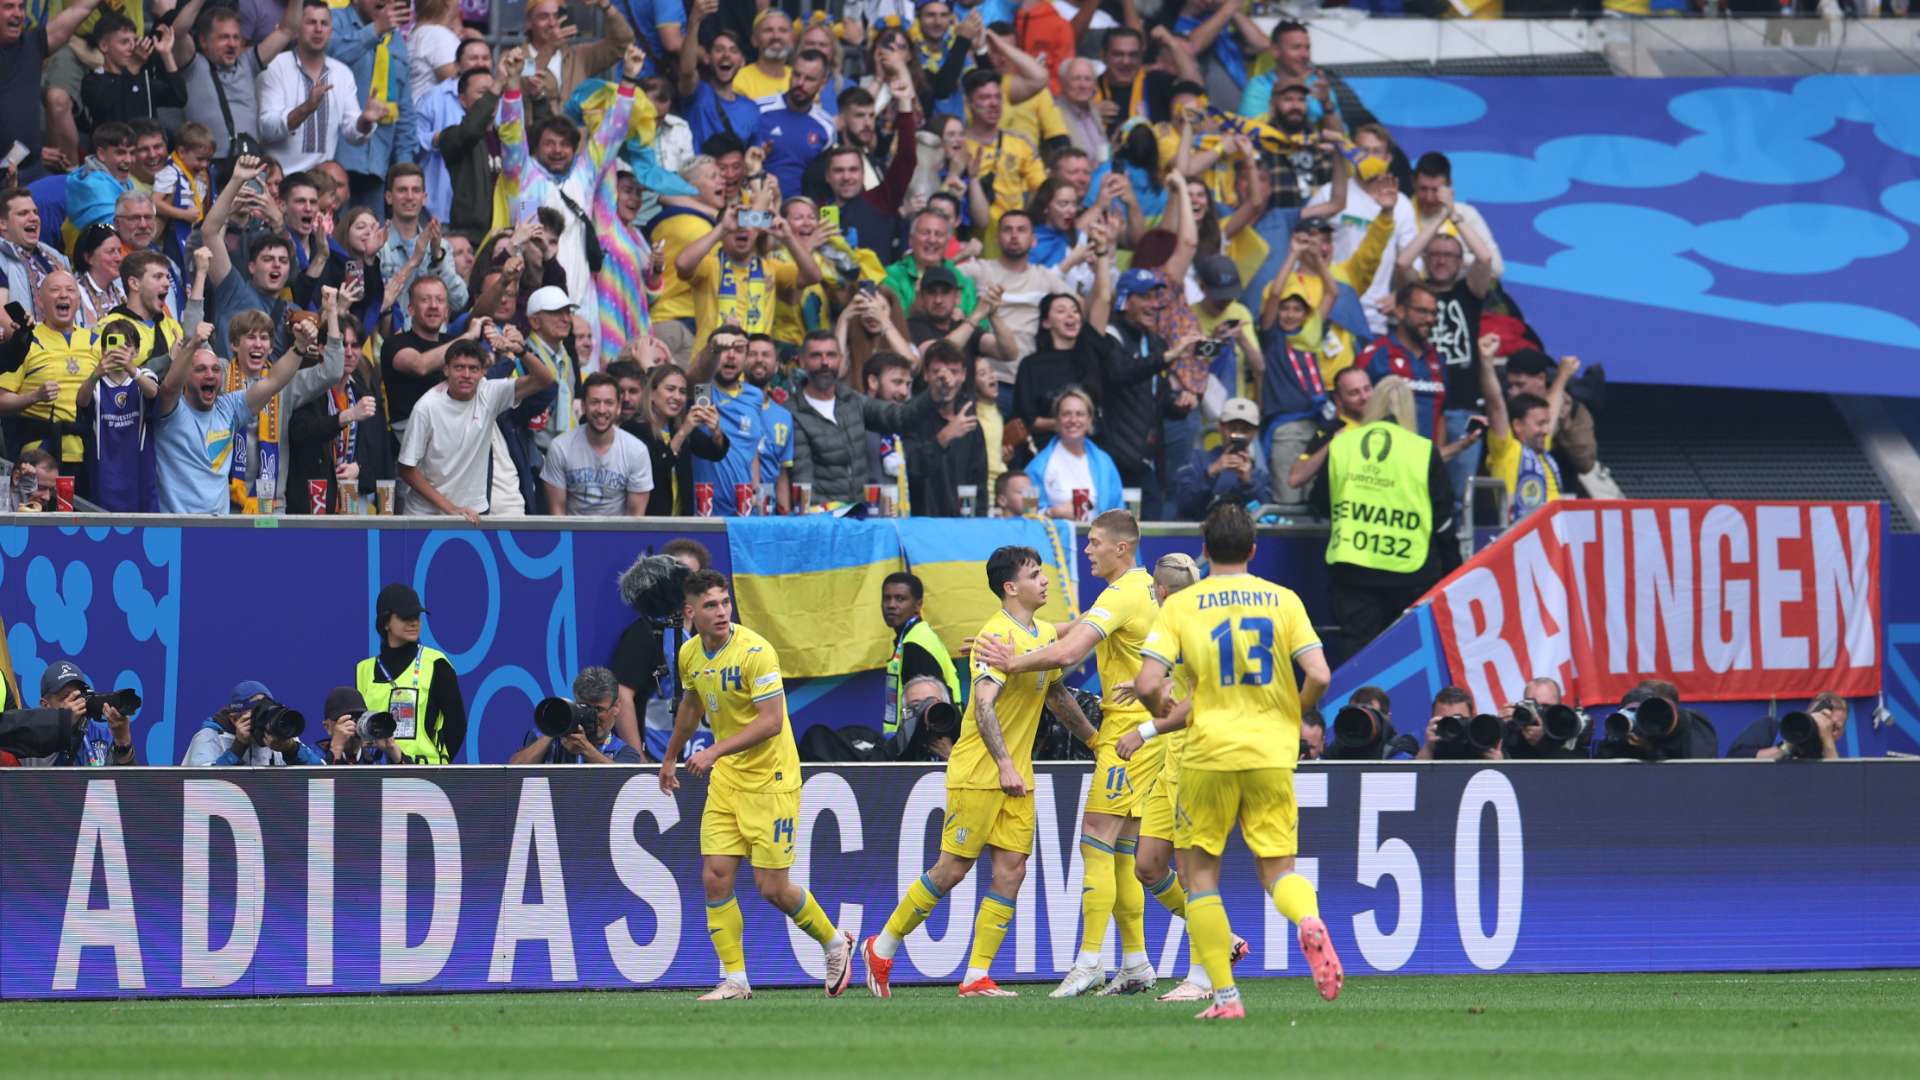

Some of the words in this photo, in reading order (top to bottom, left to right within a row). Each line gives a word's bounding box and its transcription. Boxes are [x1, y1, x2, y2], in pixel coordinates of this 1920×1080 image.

[1197, 590, 1279, 610] ZABARNYI
[1444, 505, 1876, 715] RATINGEN
[1210, 616, 1274, 687] 13
[719, 665, 743, 692] 14
[1106, 766, 1126, 791] 11
[772, 817, 794, 844] 14
